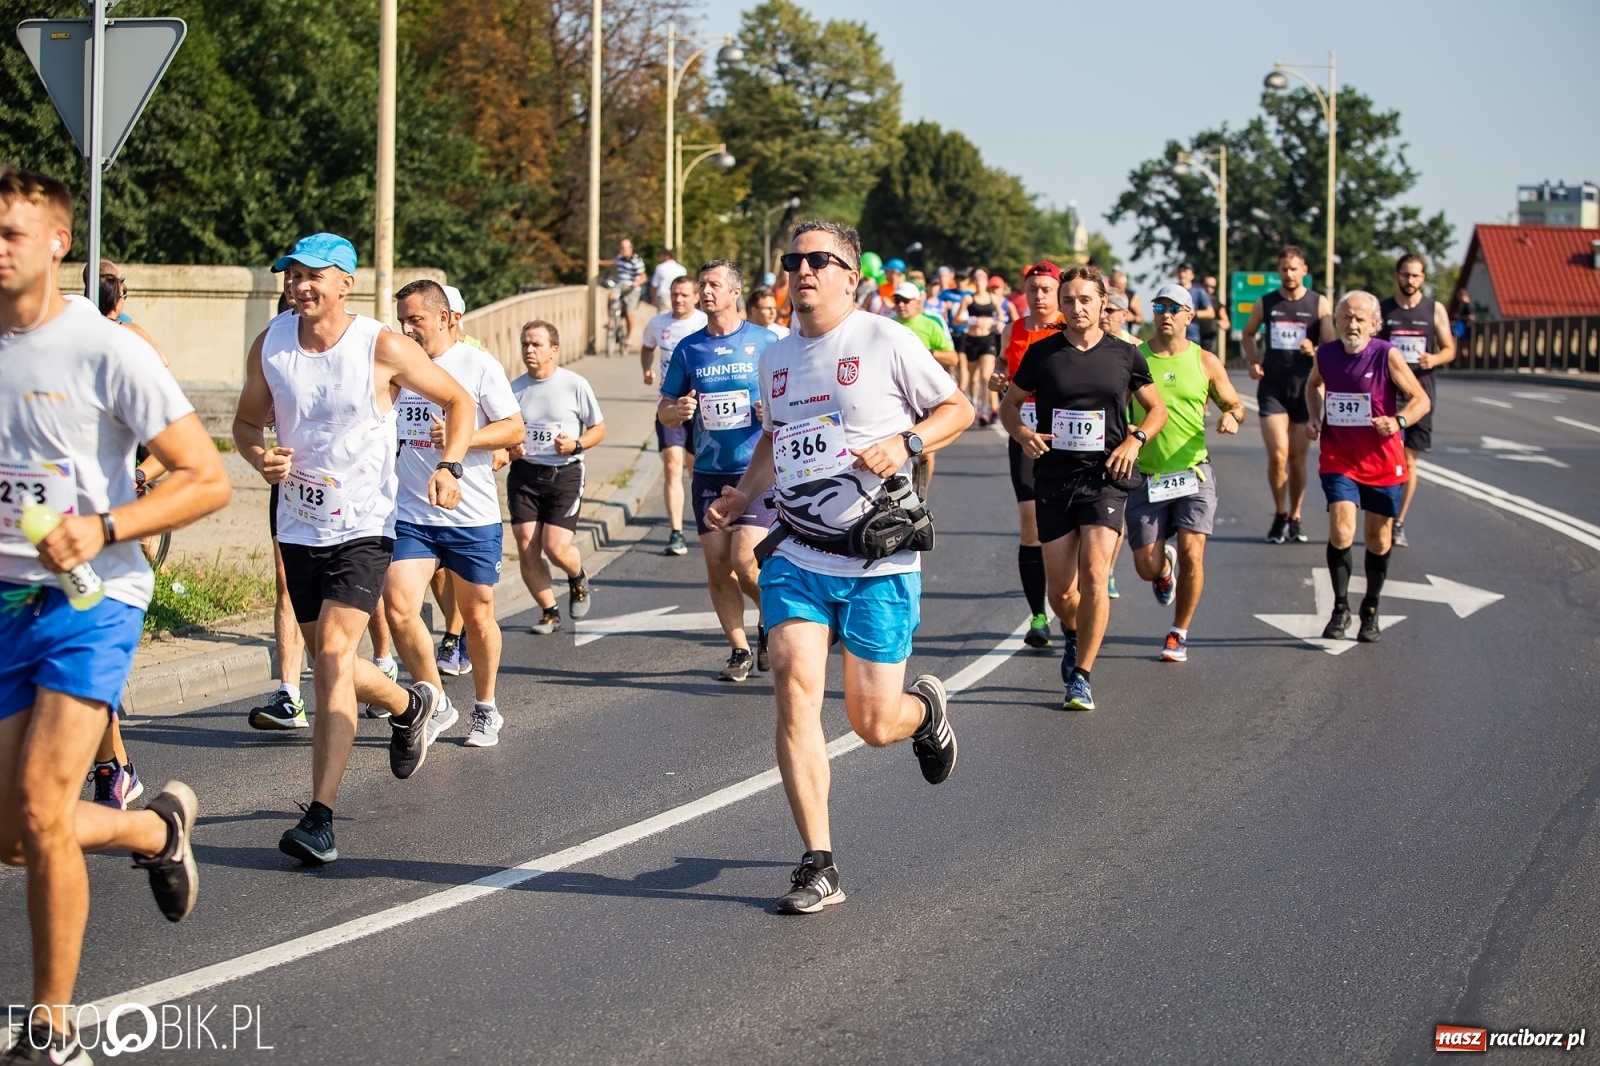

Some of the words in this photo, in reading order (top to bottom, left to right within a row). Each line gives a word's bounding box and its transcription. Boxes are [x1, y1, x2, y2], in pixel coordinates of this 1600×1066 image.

[695, 362, 754, 379] RUNNERS
[406, 406, 430, 421] 336
[715, 402, 737, 415] 151
[1339, 402, 1360, 413] 347
[1068, 421, 1092, 435] 119
[532, 430, 552, 442] 363
[790, 433, 827, 460] 366
[1163, 477, 1186, 489] 248
[298, 483, 325, 506] 123
